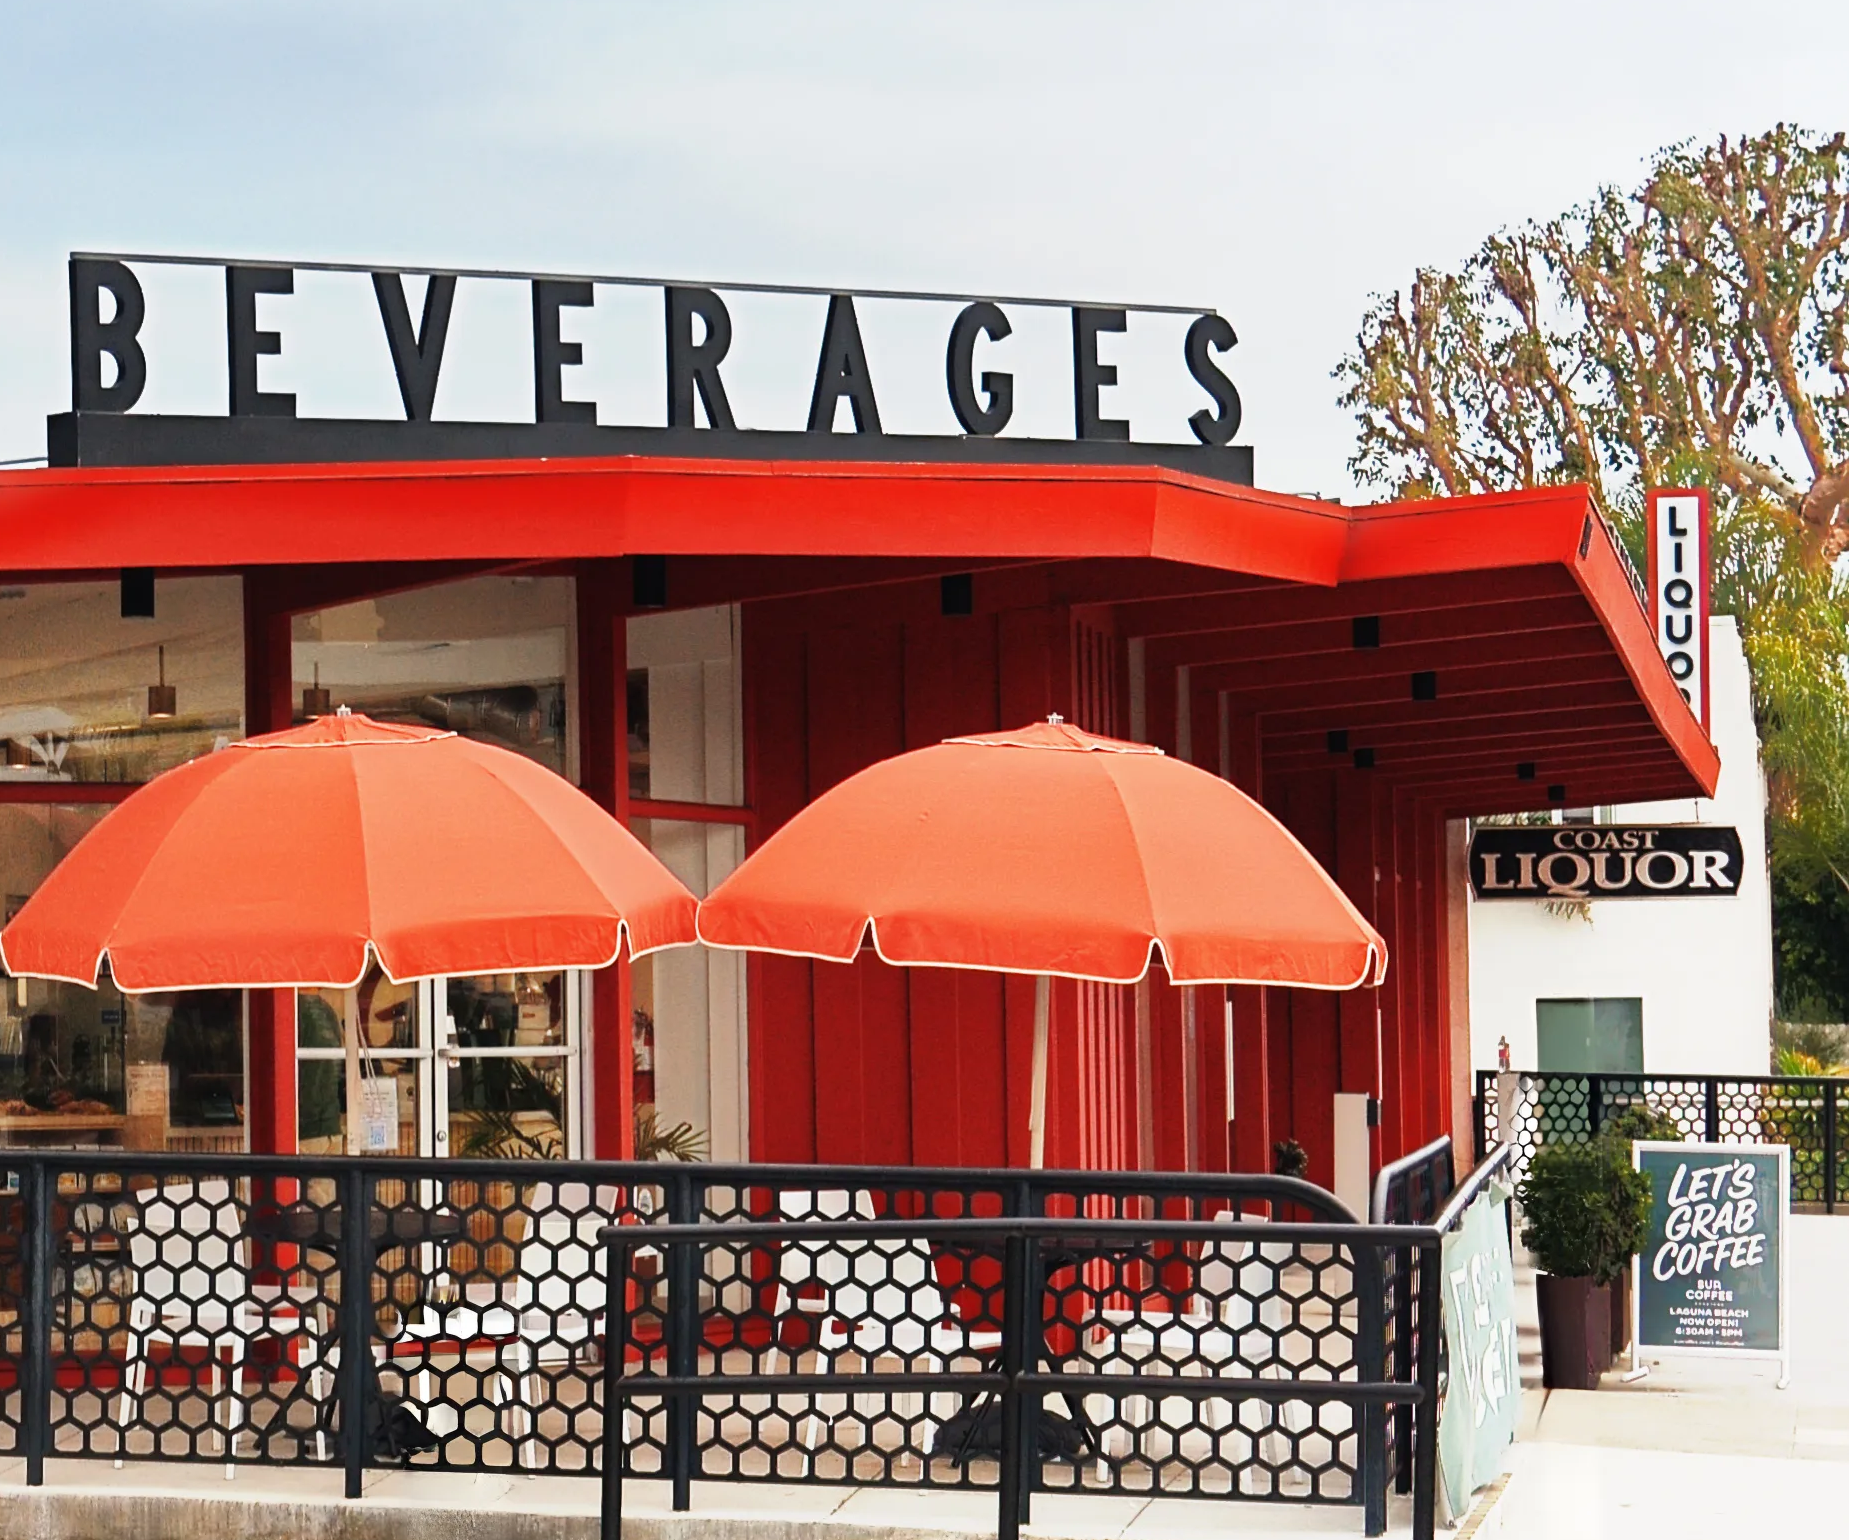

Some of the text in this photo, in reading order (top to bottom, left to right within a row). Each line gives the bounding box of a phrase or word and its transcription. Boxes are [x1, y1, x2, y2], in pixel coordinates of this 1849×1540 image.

[70, 259, 1243, 447] BEVERAGES
[1664, 506, 1694, 705] LIQUO
[1553, 830, 1660, 850] COAST
[1480, 850, 1735, 897] LIQUOR
[1667, 1159, 1756, 1208] LET'S
[1665, 1199, 1758, 1242] GRAB
[1652, 1233, 1766, 1281] COFFEE
[1669, 1307, 1749, 1318] LAGUNA BEACH
[1685, 1289, 1733, 1301] COFFEE
[1679, 1318, 1705, 1326] NOW
